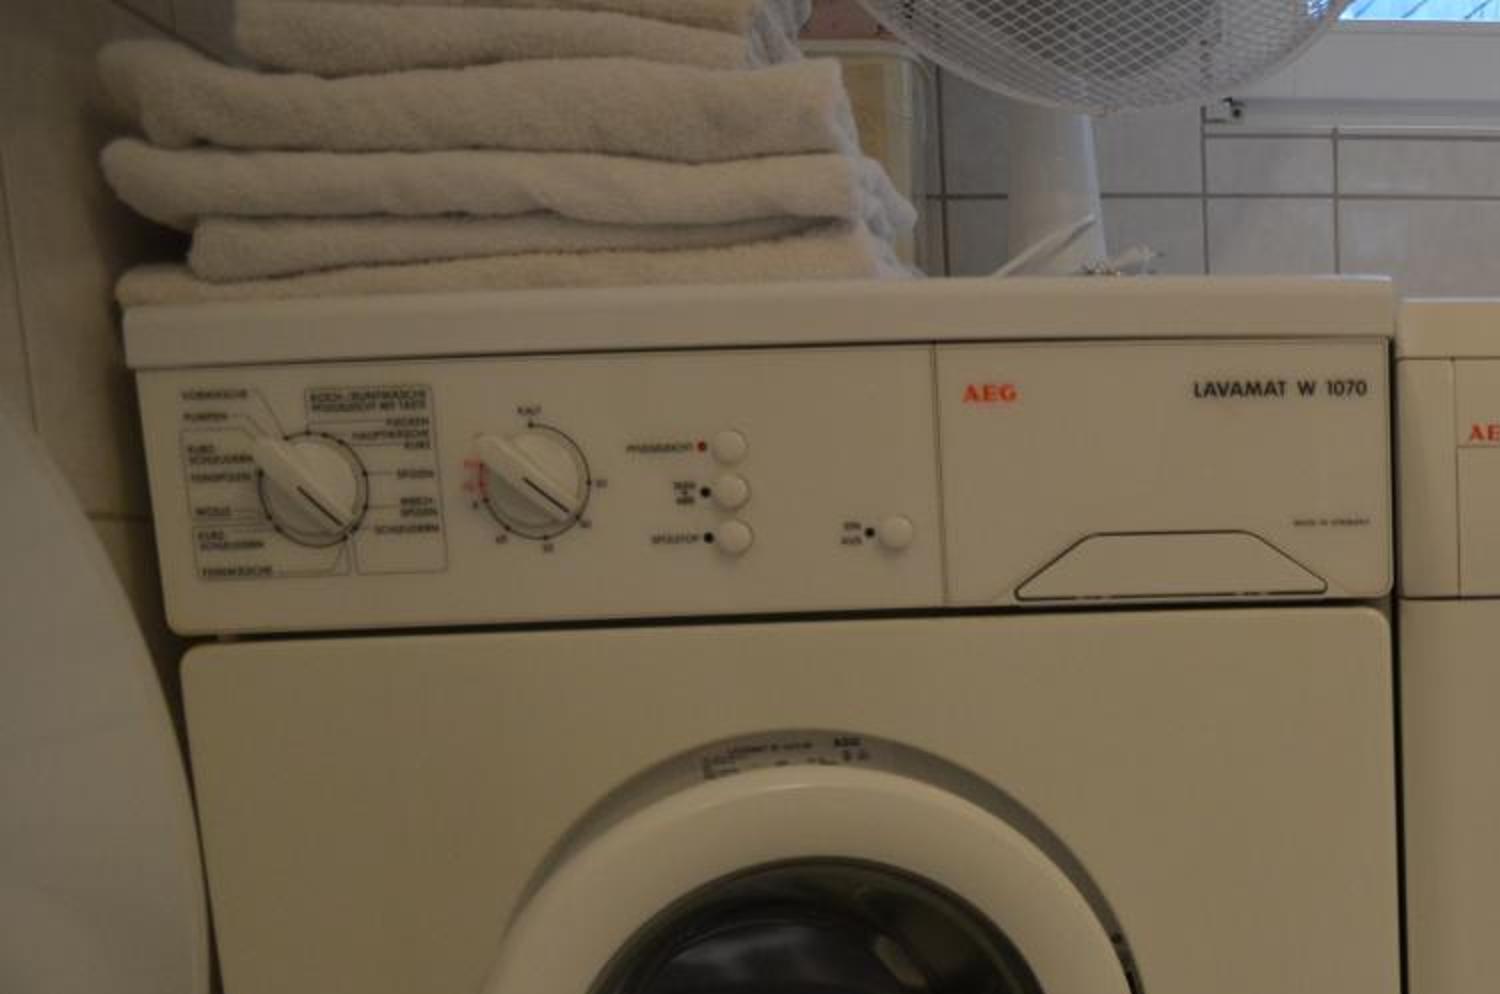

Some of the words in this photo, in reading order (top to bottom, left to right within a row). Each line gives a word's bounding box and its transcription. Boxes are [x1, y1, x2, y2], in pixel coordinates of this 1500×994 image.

[962, 383, 1018, 404] AEG
[1193, 379, 1287, 400] LAVAMAT
[1297, 379, 1317, 398] W
[1327, 378, 1369, 398] 1070
